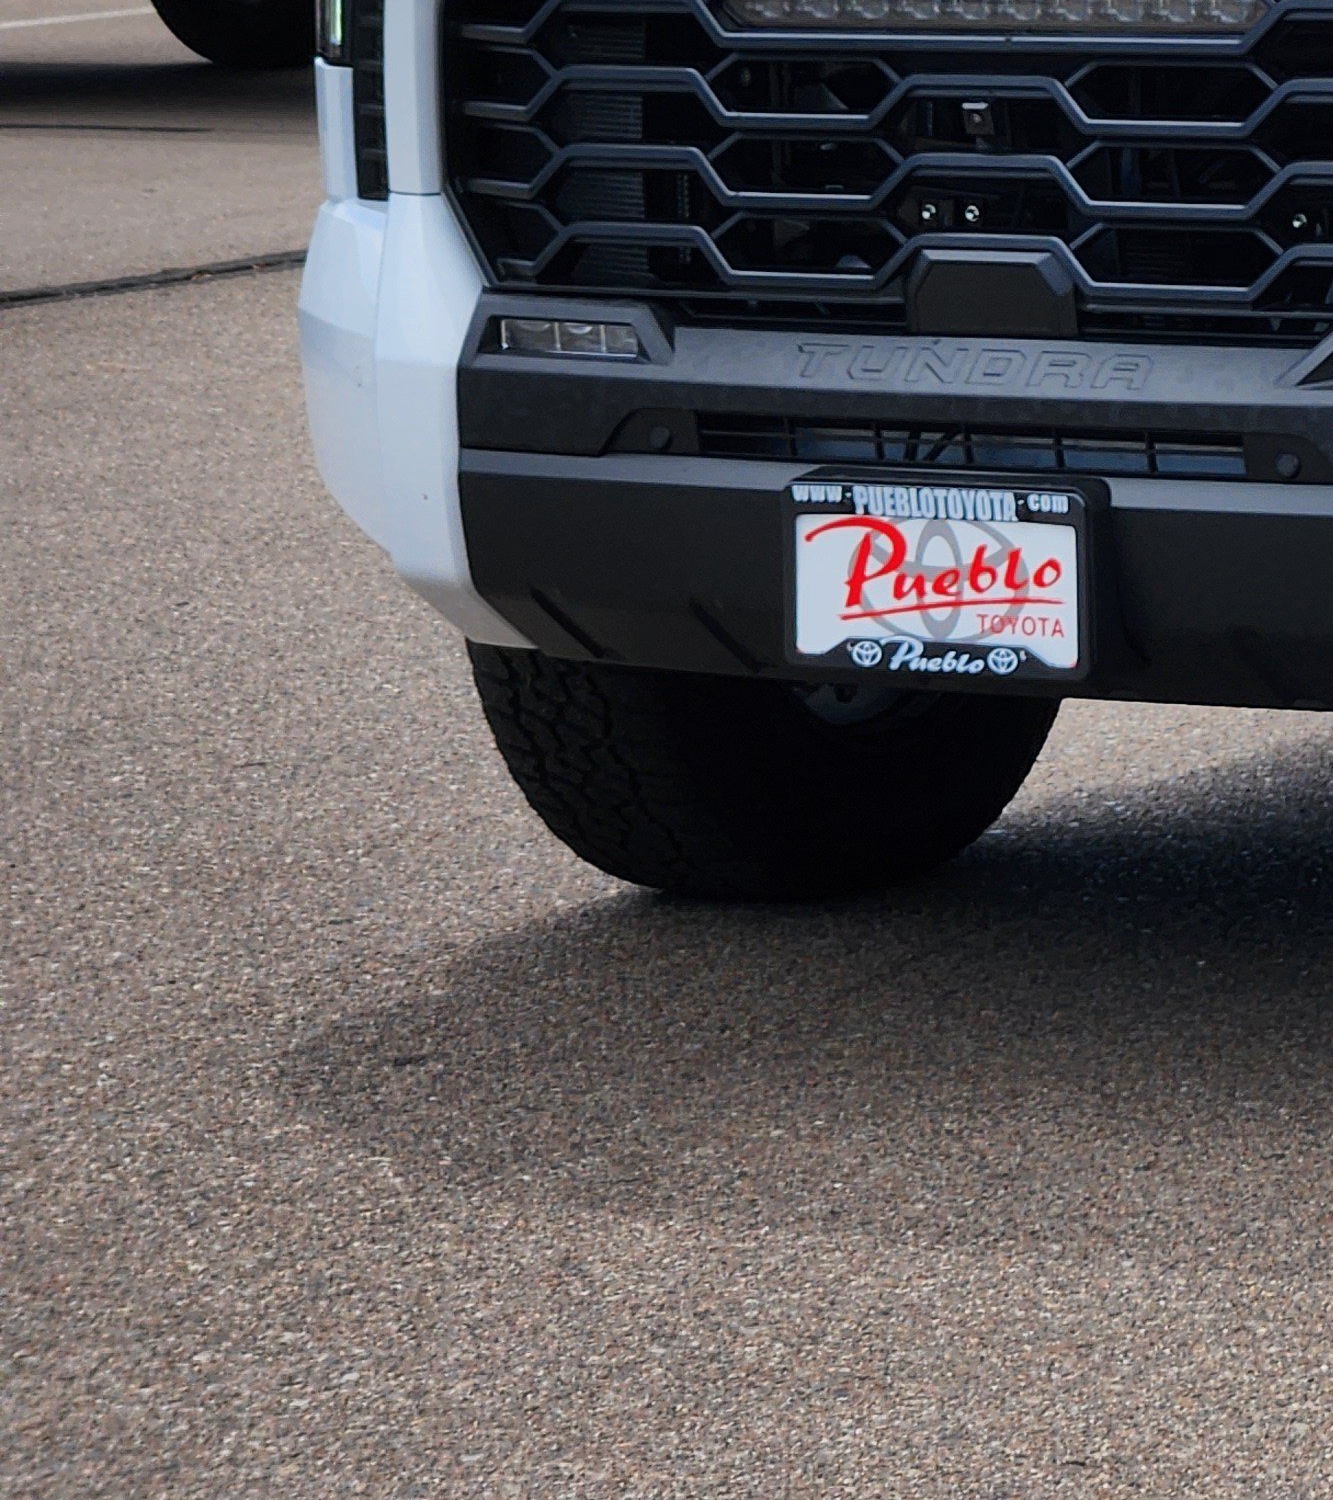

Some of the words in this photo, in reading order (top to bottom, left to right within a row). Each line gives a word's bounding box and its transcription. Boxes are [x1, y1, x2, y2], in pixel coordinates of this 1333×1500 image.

[797, 342, 1155, 391] TUNDRA
[804, 514, 1063, 608] Pueblo
[976, 613, 1065, 638] TOYOTA
[880, 635, 987, 675] Pueblo
